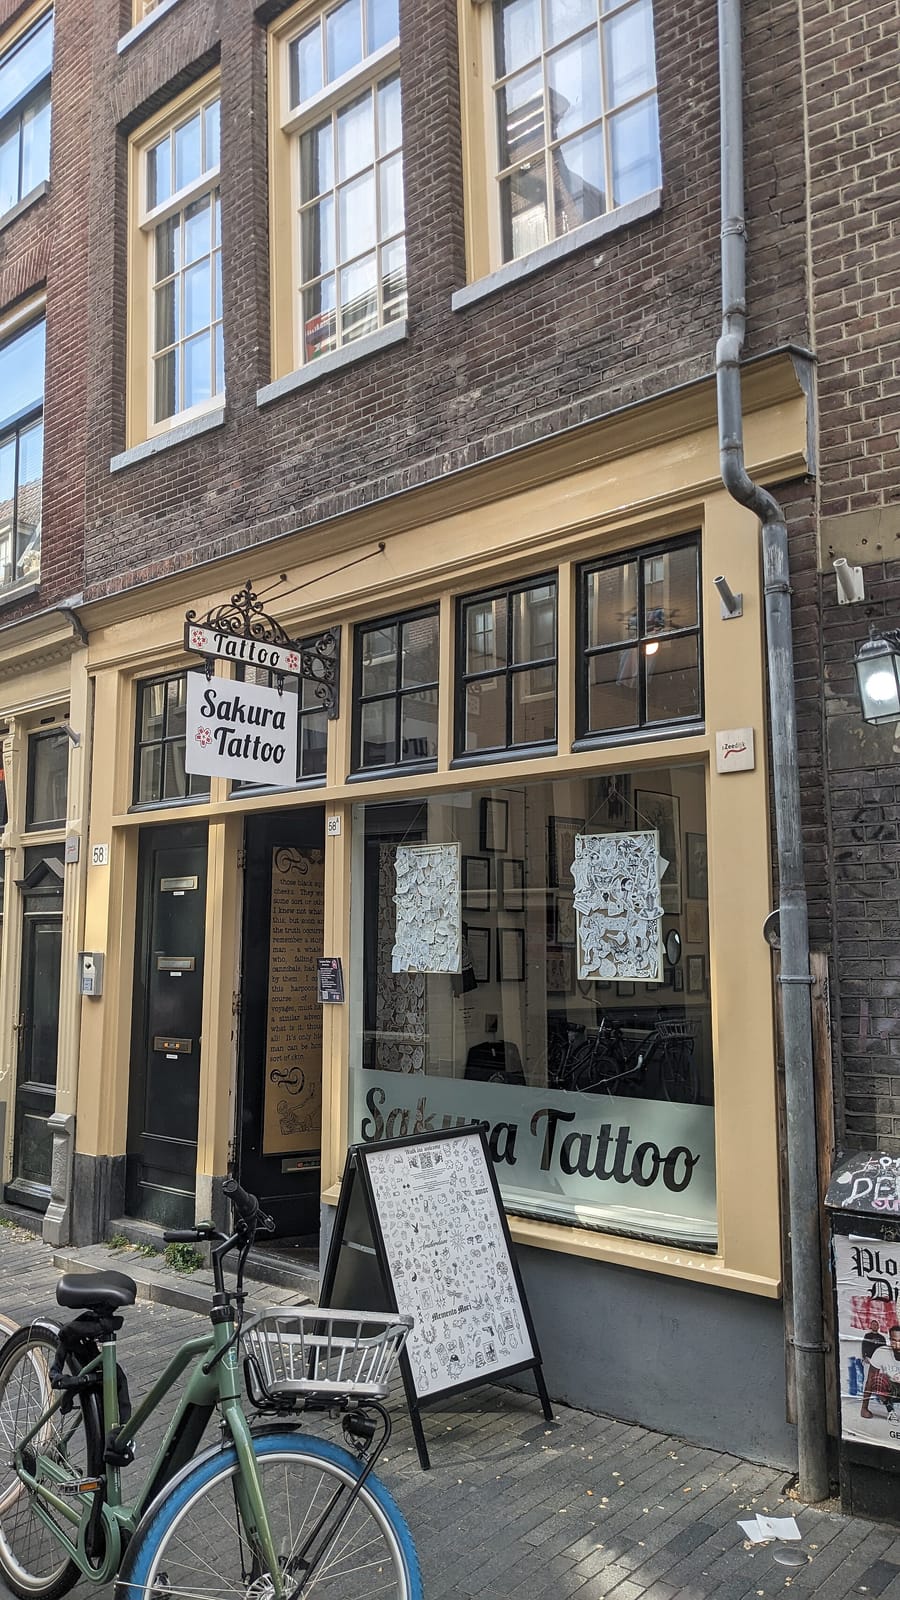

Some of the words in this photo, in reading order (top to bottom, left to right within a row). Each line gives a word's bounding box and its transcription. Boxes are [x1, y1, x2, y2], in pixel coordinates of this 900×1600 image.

[214, 634, 280, 666] Tattoo
[201, 689, 286, 730] Sakura
[214, 726, 286, 764] Tattoo
[94, 847, 104, 863] 58
[362, 1087, 518, 1165] Saka
[530, 1108, 701, 1192] Tattoo
[432, 1309, 457, 1322] Memento
